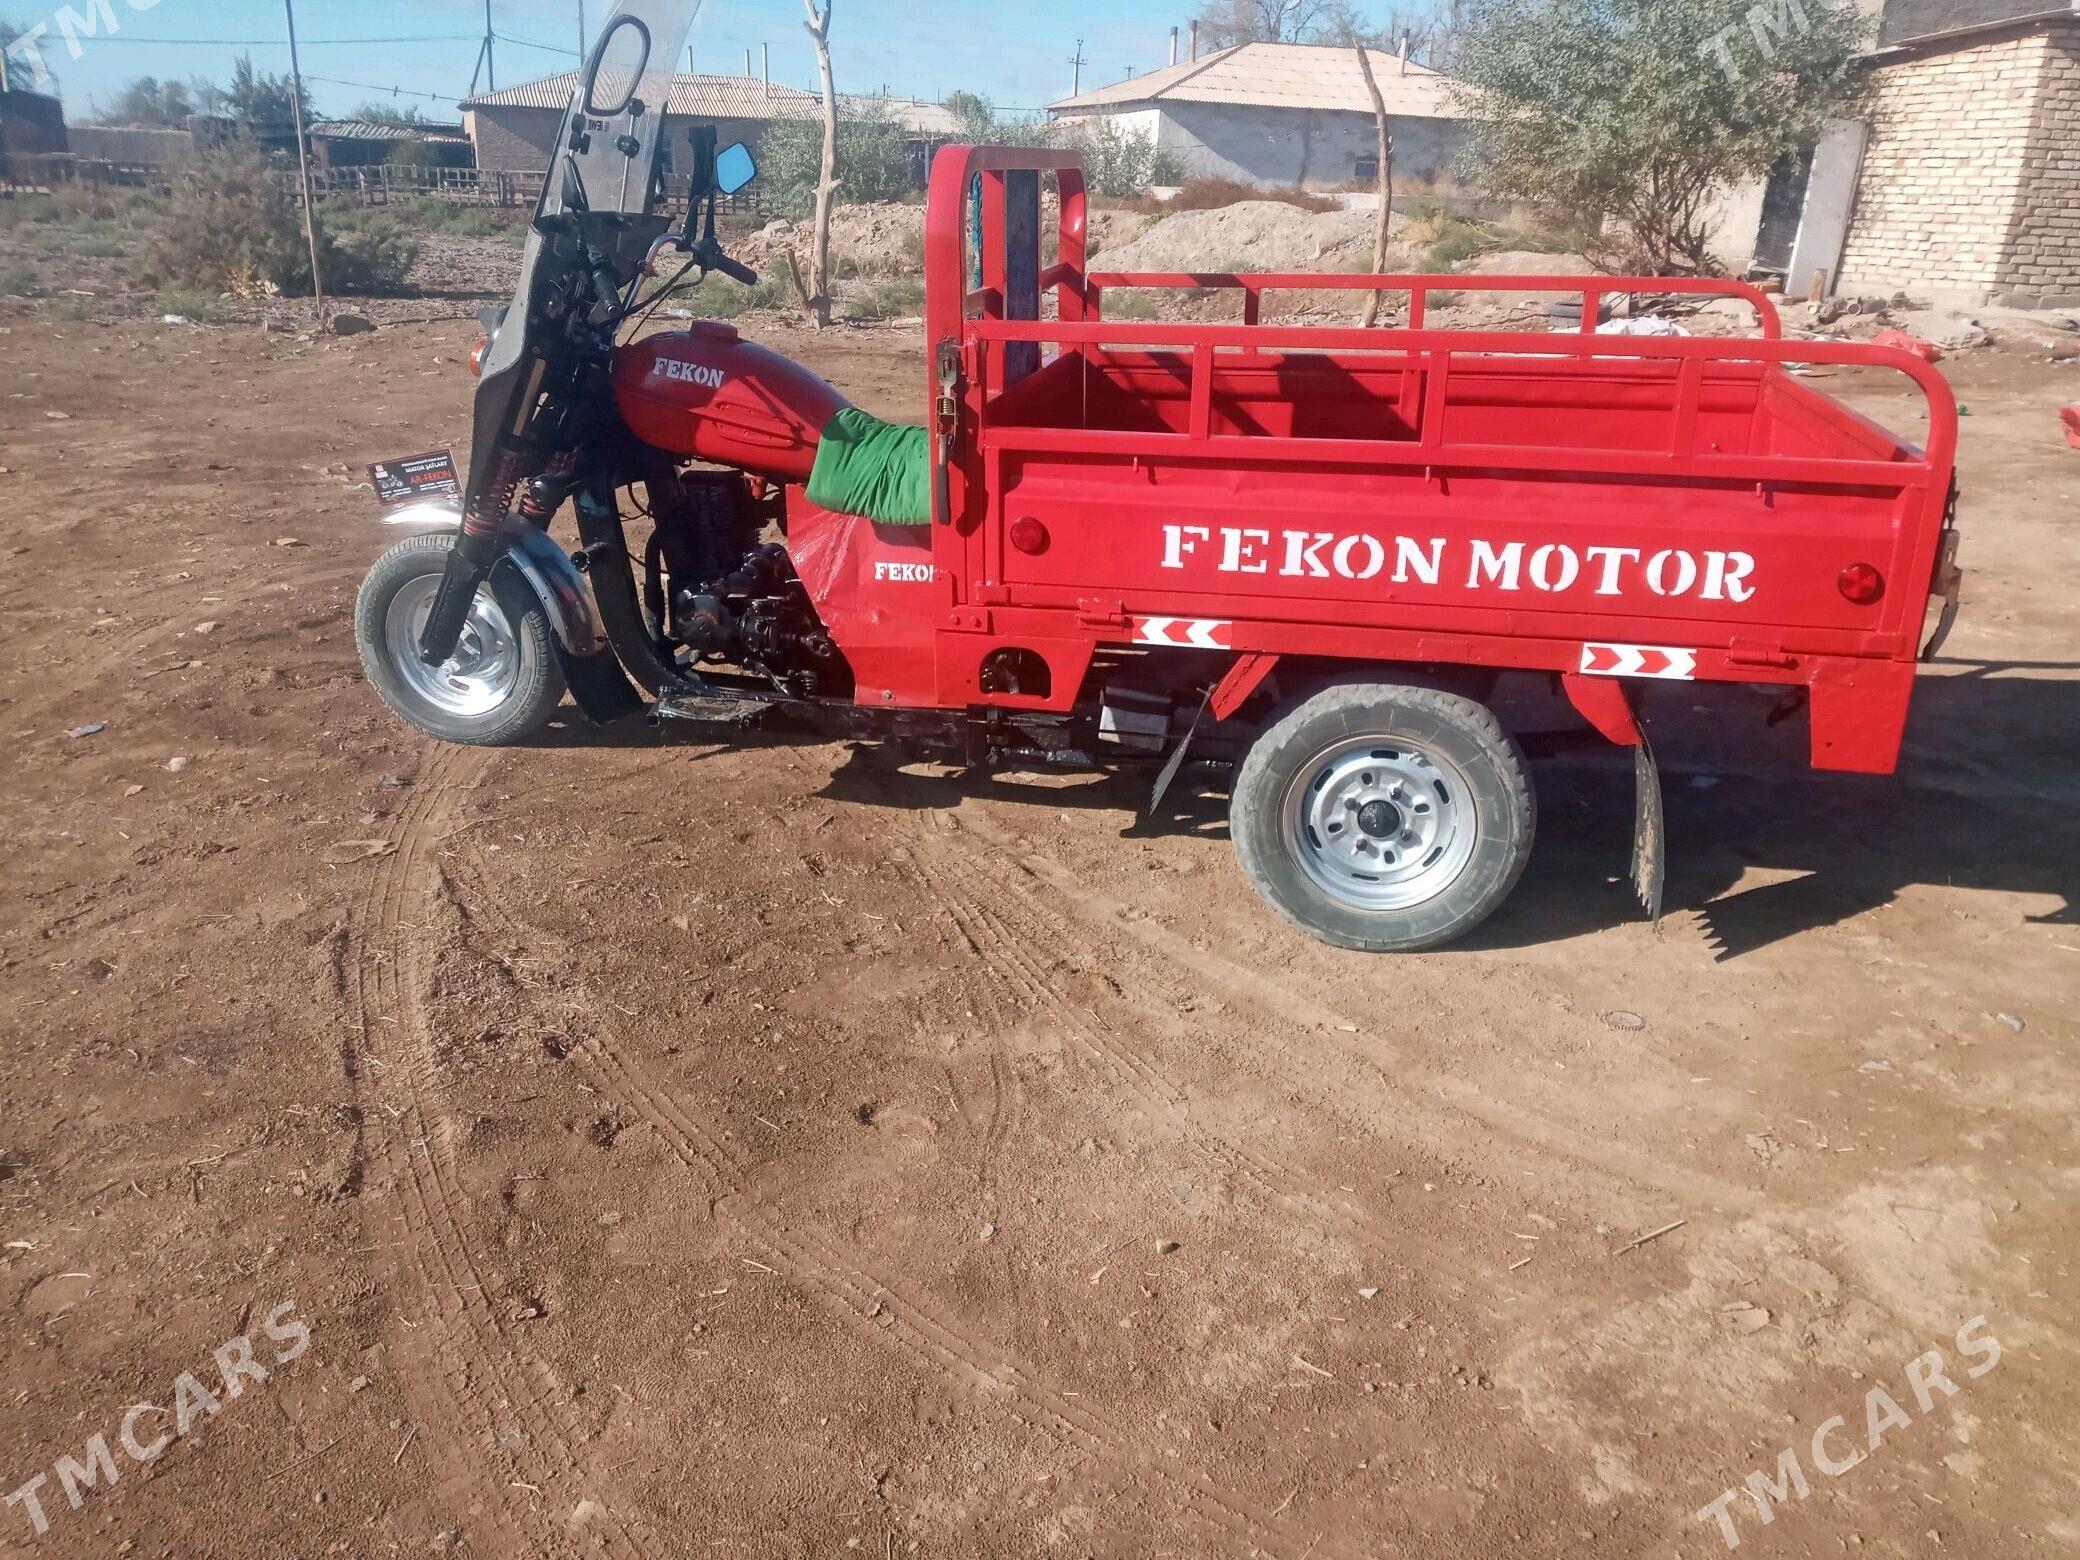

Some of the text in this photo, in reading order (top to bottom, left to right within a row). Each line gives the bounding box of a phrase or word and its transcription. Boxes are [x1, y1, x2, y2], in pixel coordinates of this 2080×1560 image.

[653, 357, 724, 388] FEKON
[1161, 525, 1756, 602] FEKON MOTOR
